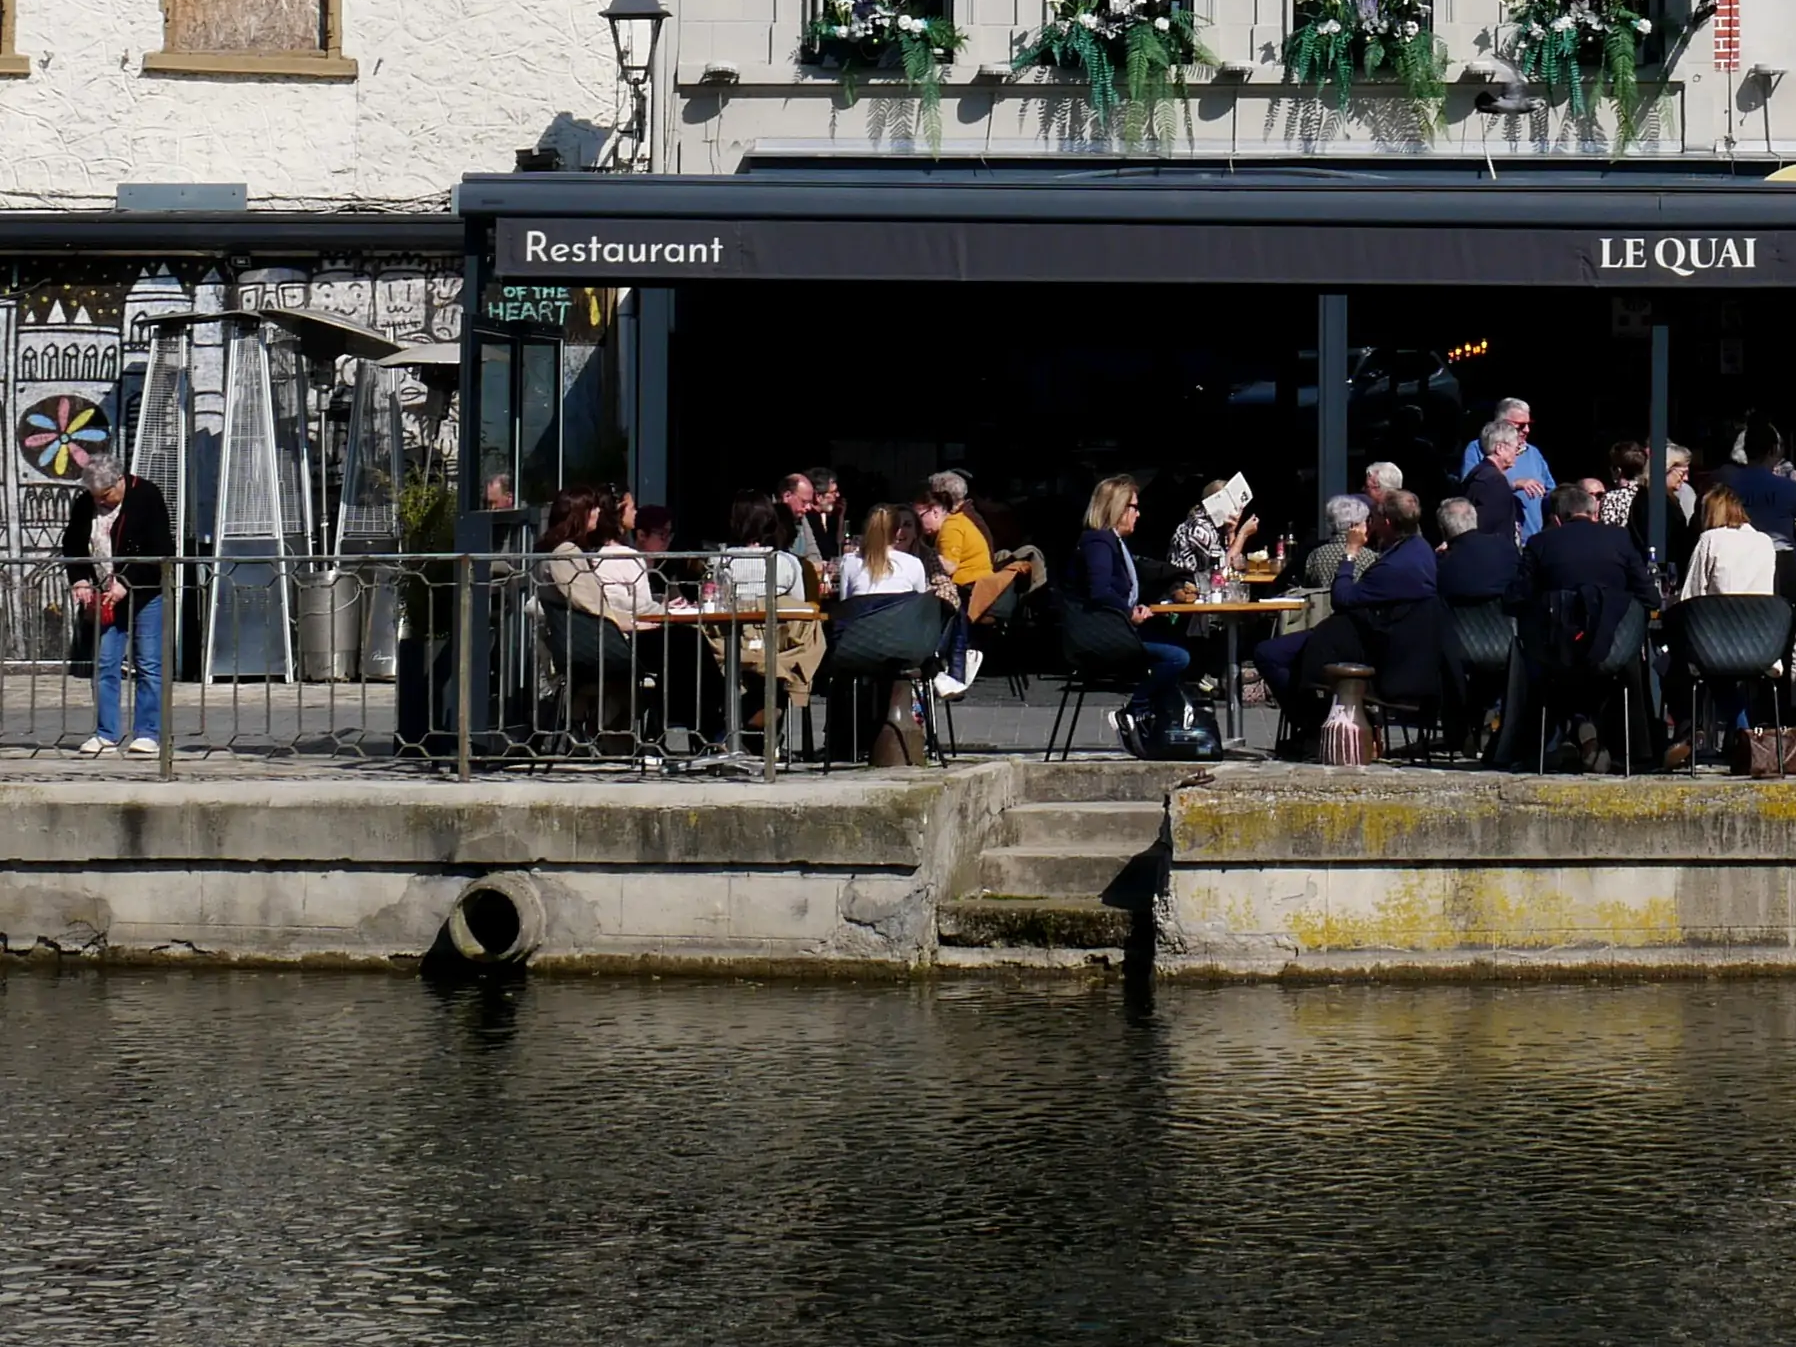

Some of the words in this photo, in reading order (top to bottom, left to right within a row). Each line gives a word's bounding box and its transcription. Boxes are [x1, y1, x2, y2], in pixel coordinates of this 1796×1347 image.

[525, 230, 724, 263] Restaurant
[1599, 238, 1648, 268] LE
[1654, 237, 1757, 277] QUAI
[503, 286, 528, 301] OF
[531, 286, 570, 299] THE
[488, 300, 572, 326] HEART
